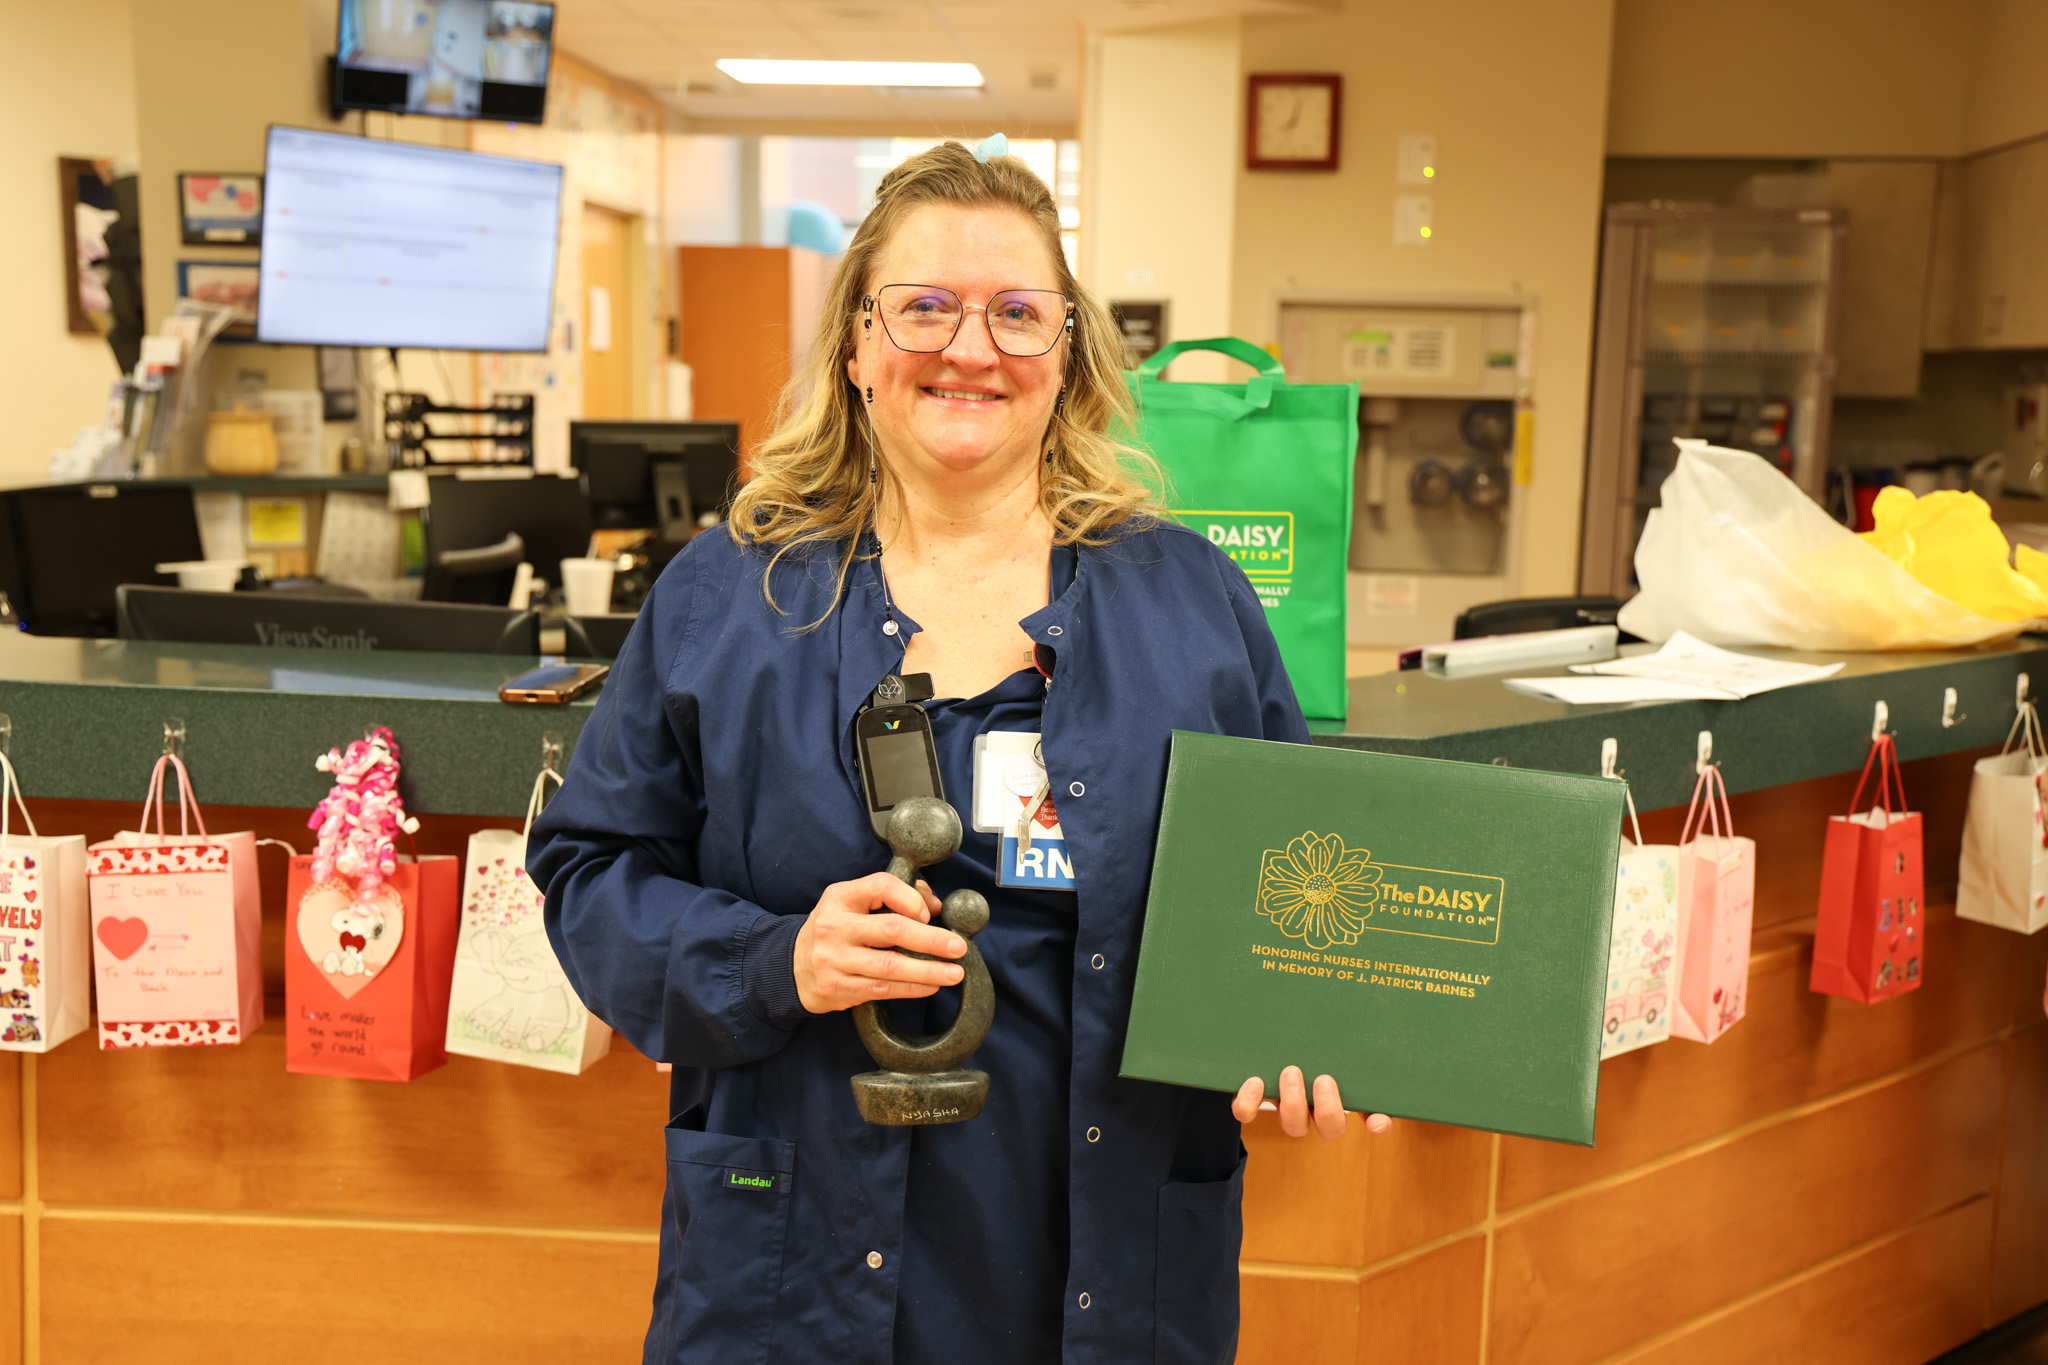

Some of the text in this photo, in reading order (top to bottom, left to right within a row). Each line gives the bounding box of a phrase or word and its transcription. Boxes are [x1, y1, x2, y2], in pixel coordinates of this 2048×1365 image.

[1207, 525, 1284, 547] DAISY
[253, 620, 379, 650] ViewSonic
[1016, 847, 1075, 879] RN
[132, 885, 167, 897] Love
[1417, 885, 1493, 912] DAISY
[1251, 944, 1491, 986] HONORING NURSES INTERNATIONALLY
[1262, 959, 1476, 998] IN MEMORY OF J. PATRICK BARNES
